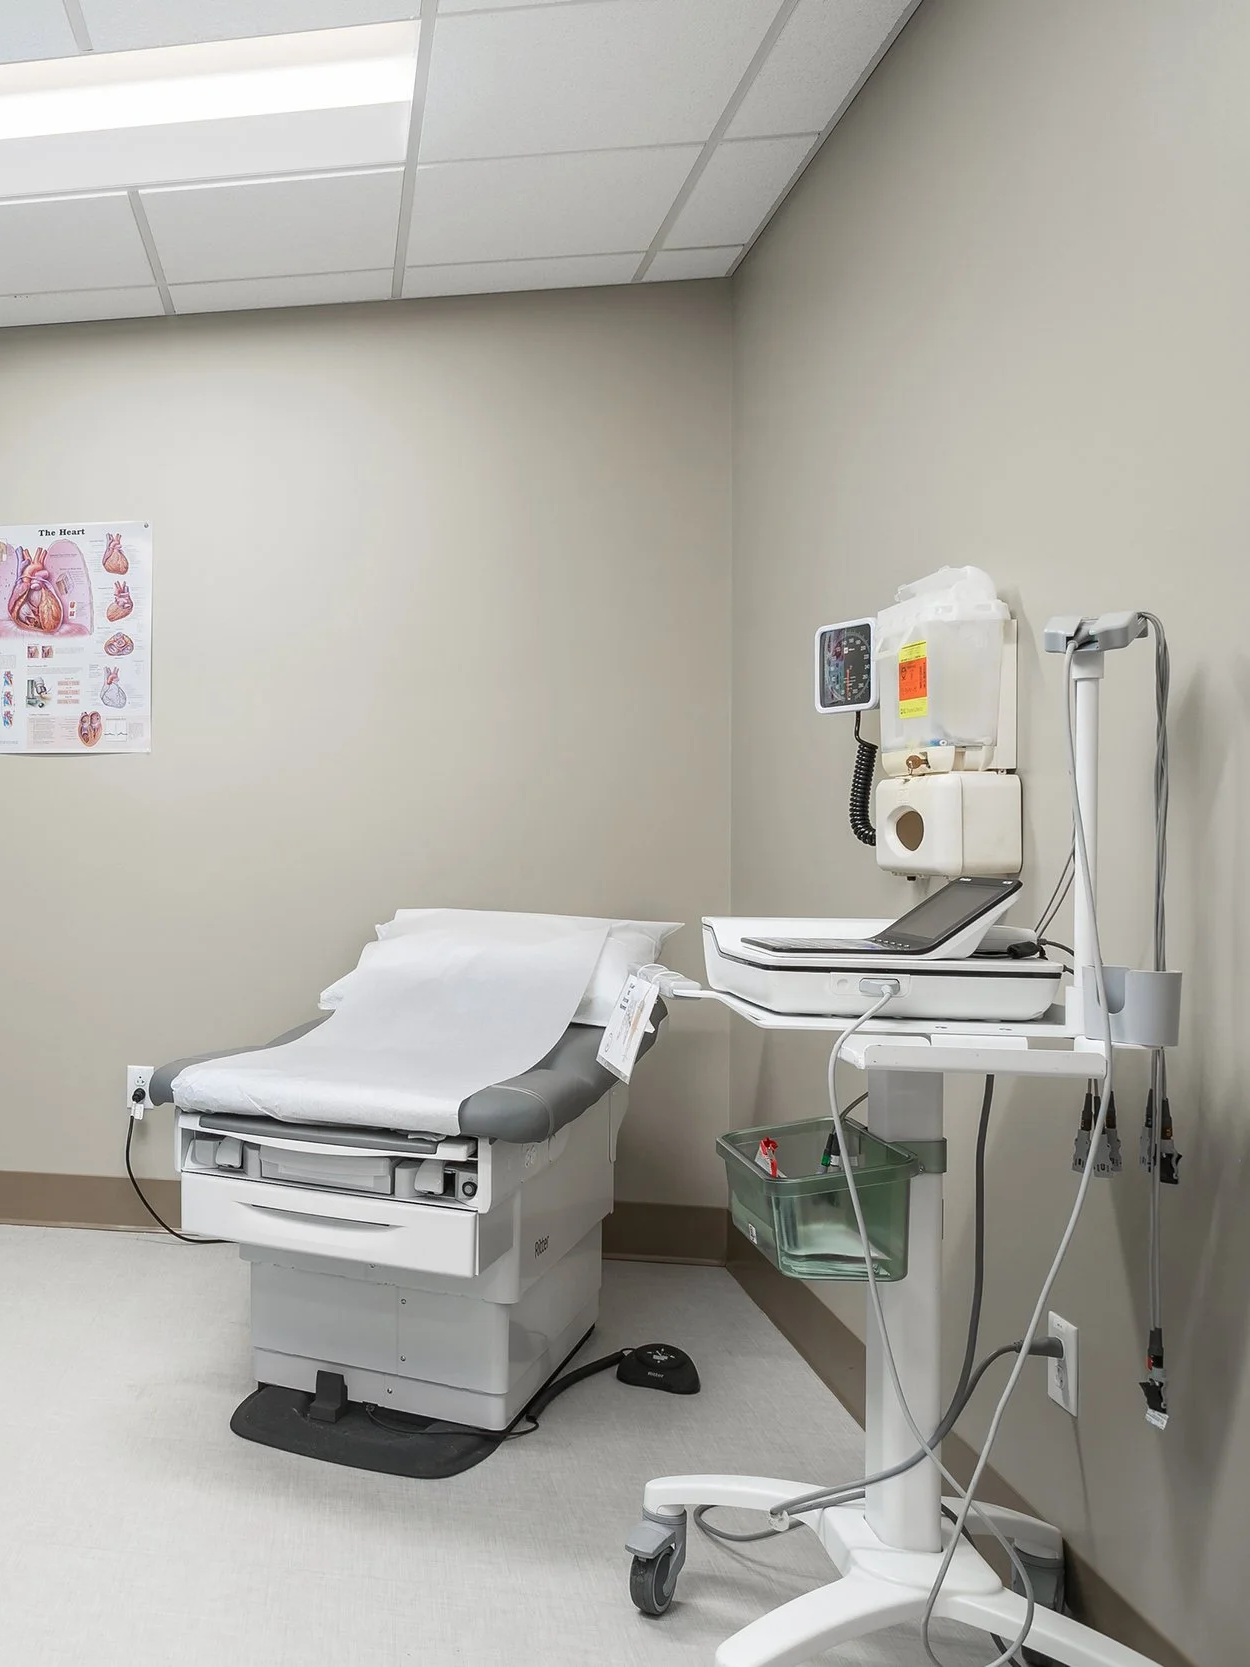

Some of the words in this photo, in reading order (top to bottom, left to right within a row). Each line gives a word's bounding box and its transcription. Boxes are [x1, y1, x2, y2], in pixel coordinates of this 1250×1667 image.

[38, 529, 56, 537] The
[59, 528, 85, 536] Heart
[535, 1235, 549, 1259] Ritter
